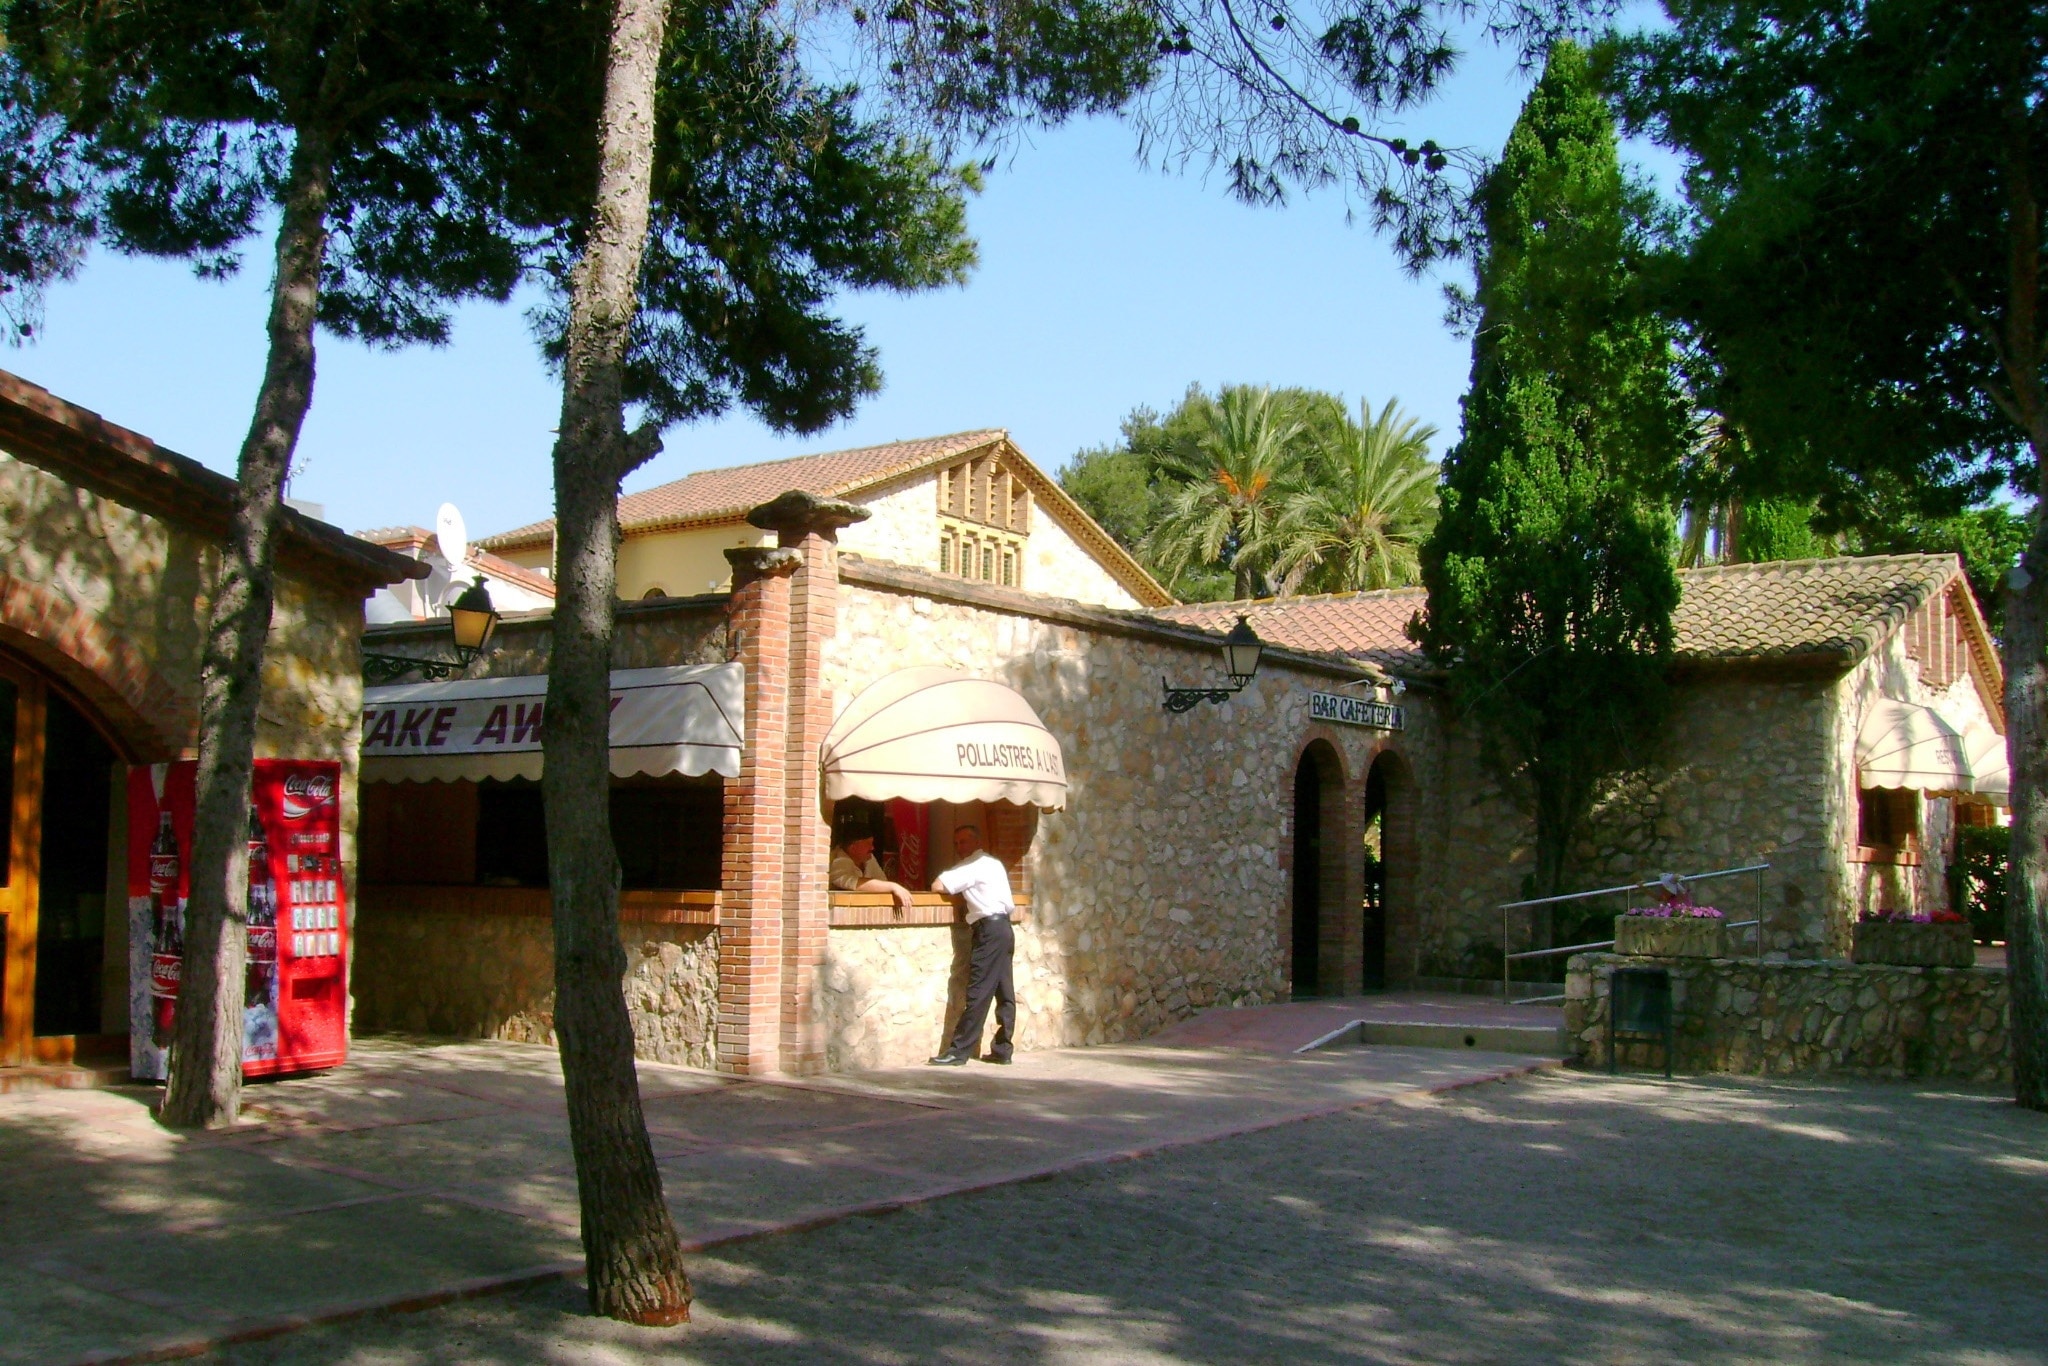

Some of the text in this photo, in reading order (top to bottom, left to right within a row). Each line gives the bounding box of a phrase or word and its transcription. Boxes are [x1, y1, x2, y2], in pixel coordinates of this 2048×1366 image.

[1312, 694, 1403, 729] BAR CAFETERIA
[956, 743, 1035, 770] POLLASTRES
[1035, 748, 1044, 772] A
